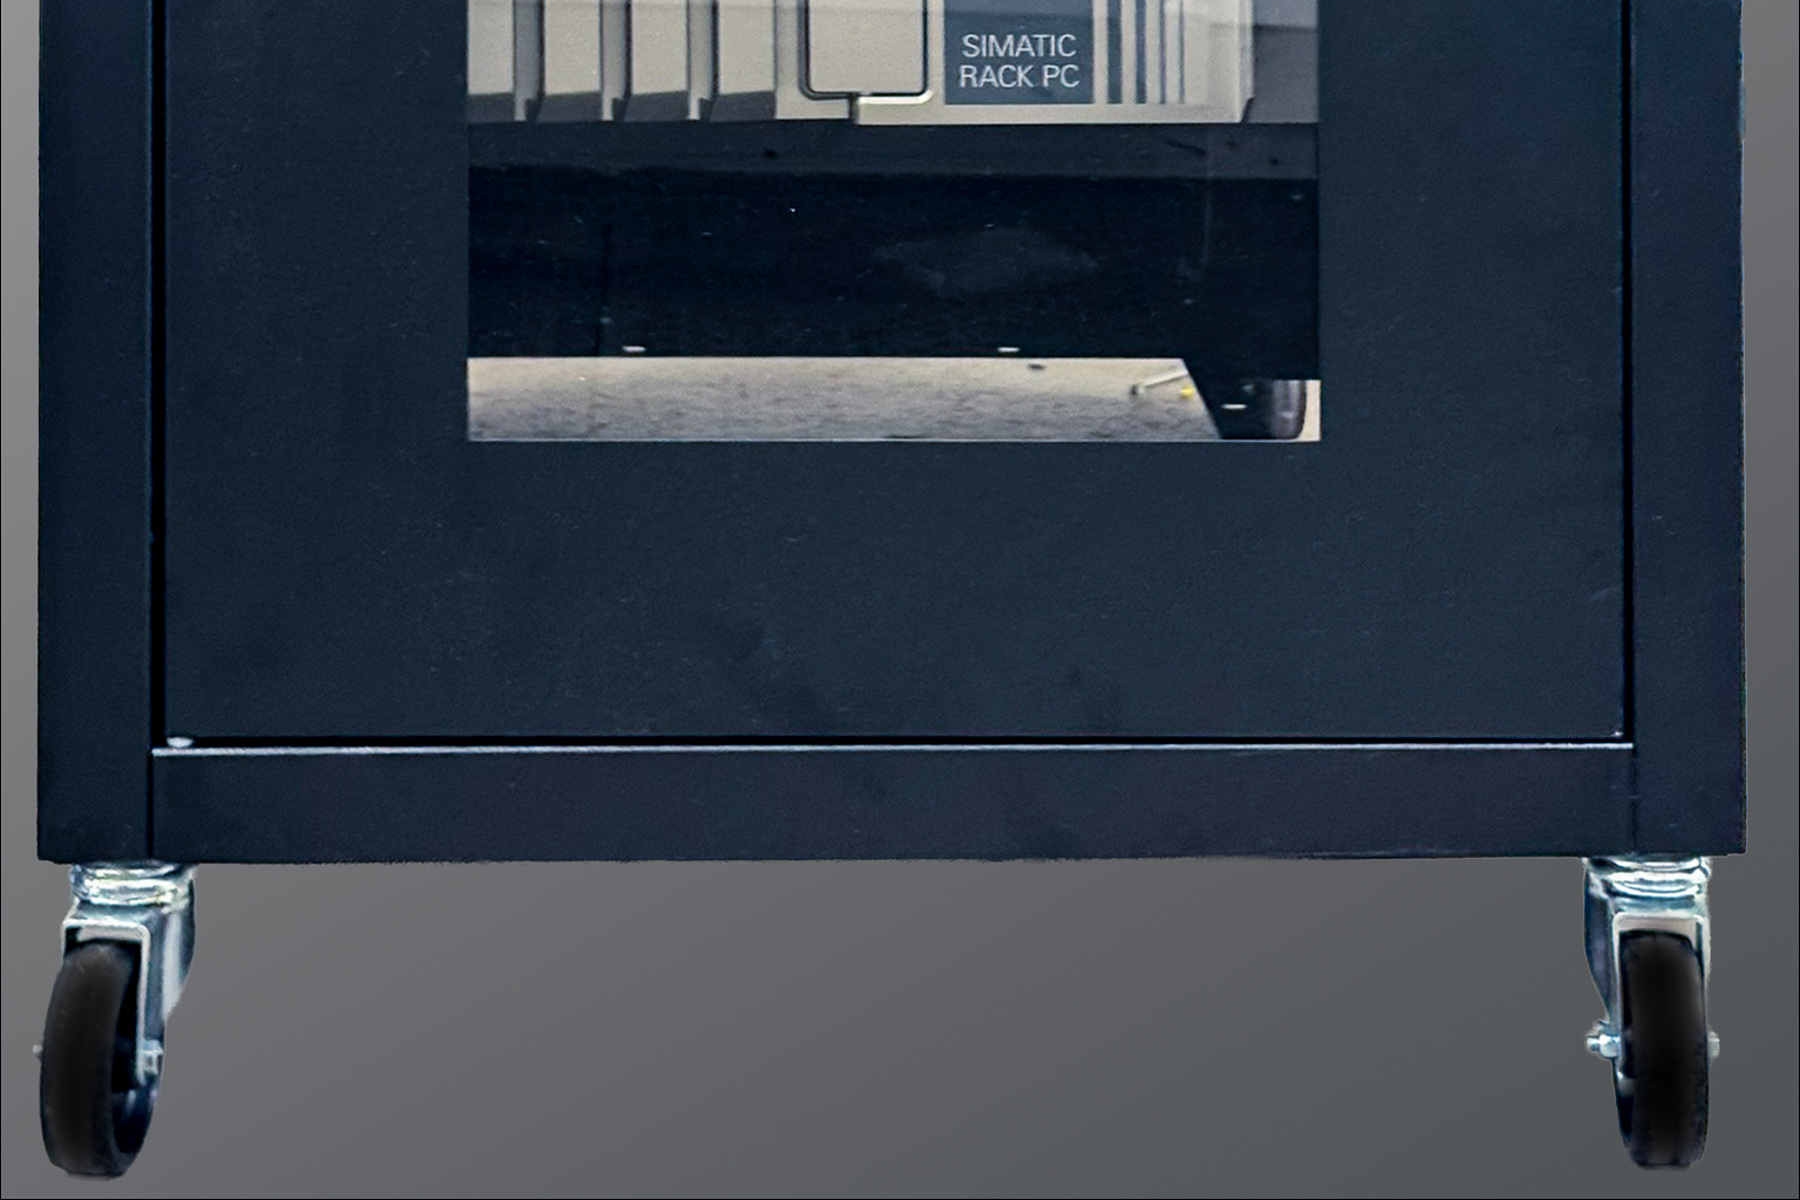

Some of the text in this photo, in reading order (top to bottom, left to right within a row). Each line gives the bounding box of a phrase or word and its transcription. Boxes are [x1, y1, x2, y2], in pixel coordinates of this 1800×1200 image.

[961, 34, 1077, 58] SIMATIC
[959, 64, 1079, 89] RACK PC
